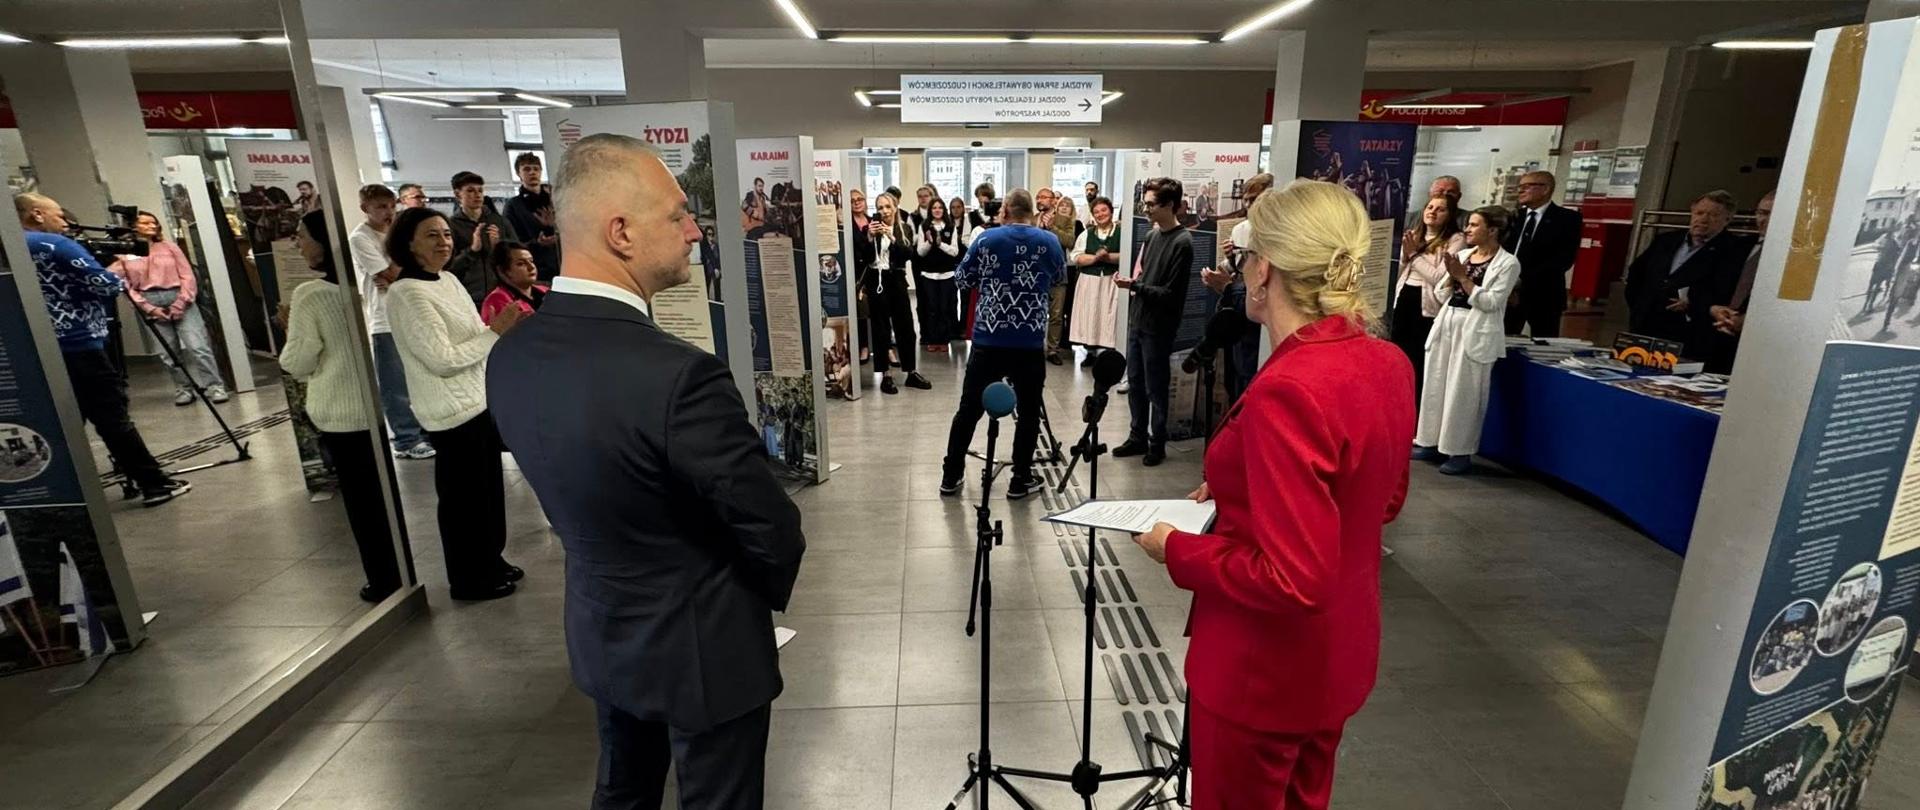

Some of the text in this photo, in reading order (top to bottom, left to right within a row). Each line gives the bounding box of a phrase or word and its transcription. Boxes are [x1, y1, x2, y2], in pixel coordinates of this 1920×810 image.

[643, 124, 689, 144] ŻYDZI
[1359, 139, 1404, 153] TATARZY
[750, 151, 789, 161] KARAIMI
[1215, 154, 1250, 165] ROSJANIE
